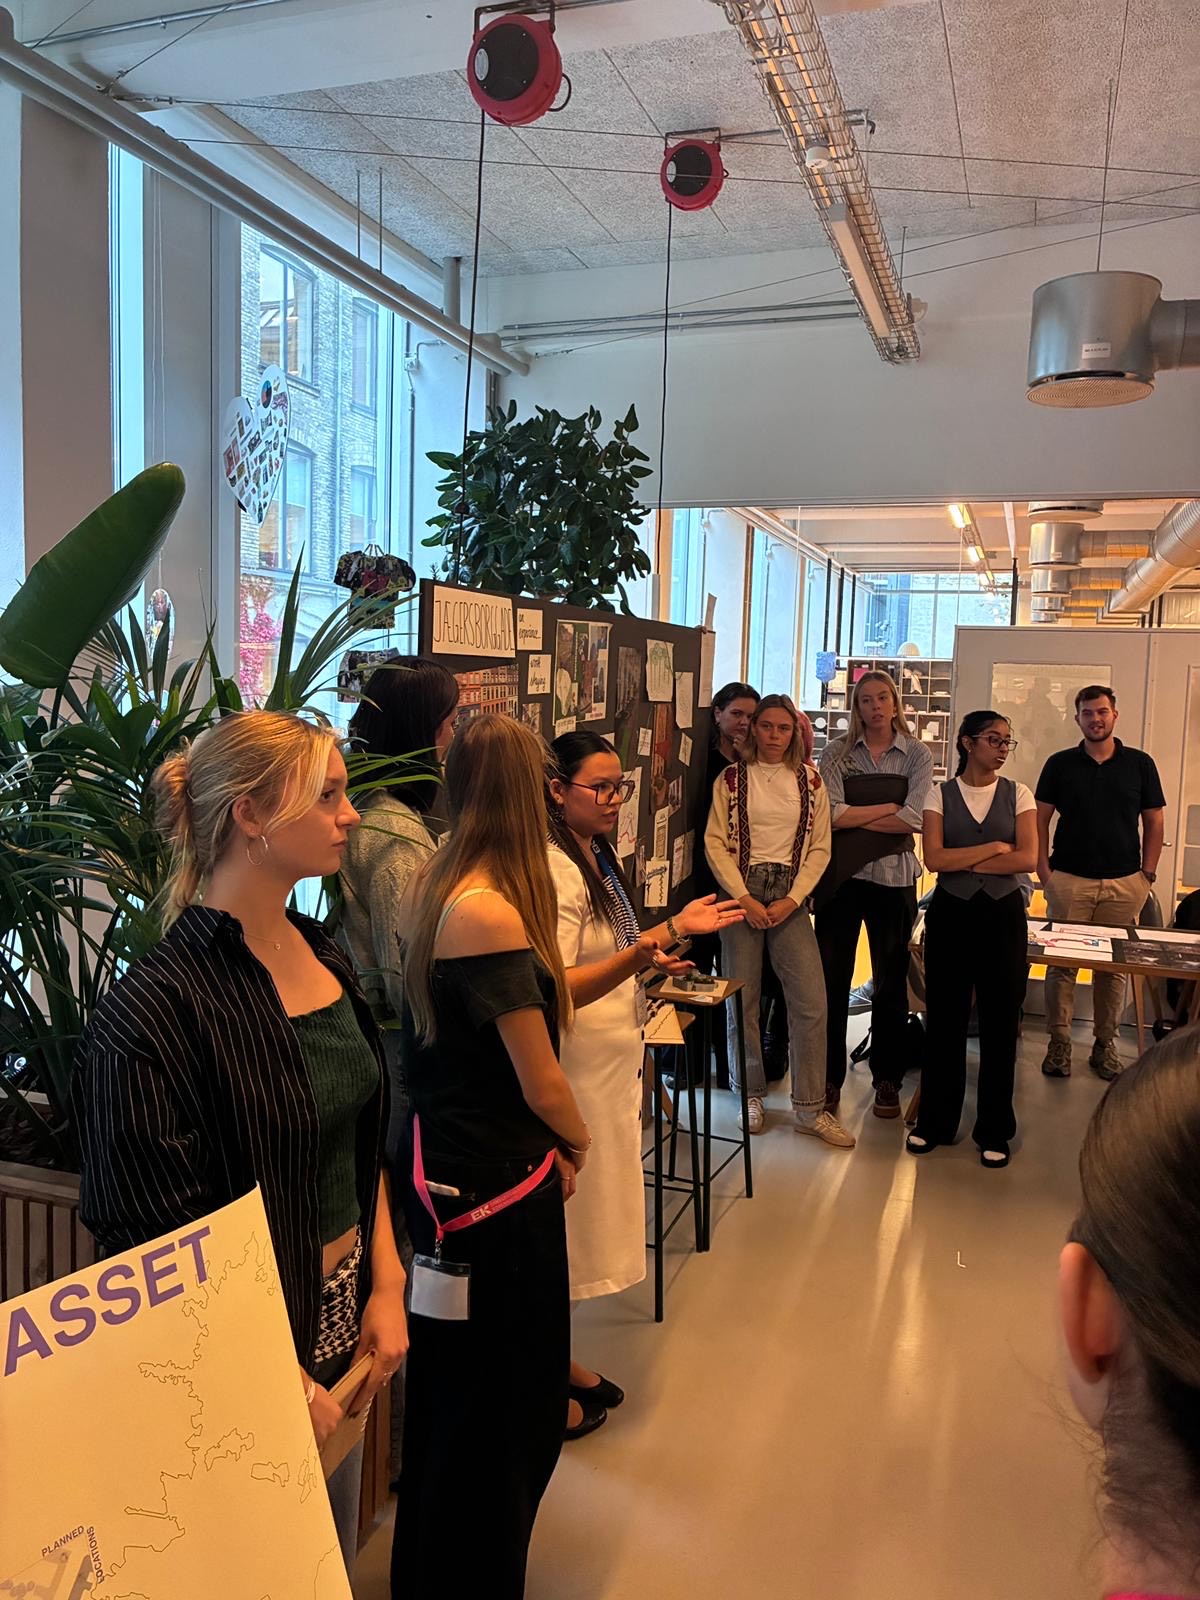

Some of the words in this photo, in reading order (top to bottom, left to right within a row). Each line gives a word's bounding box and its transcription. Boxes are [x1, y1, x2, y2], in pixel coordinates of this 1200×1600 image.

[470, 1204, 492, 1221] EK
[3, 1225, 212, 1377] ASSET
[41, 1525, 85, 1558] PLANNED
[86, 1526, 105, 1585] LOCATIONS
